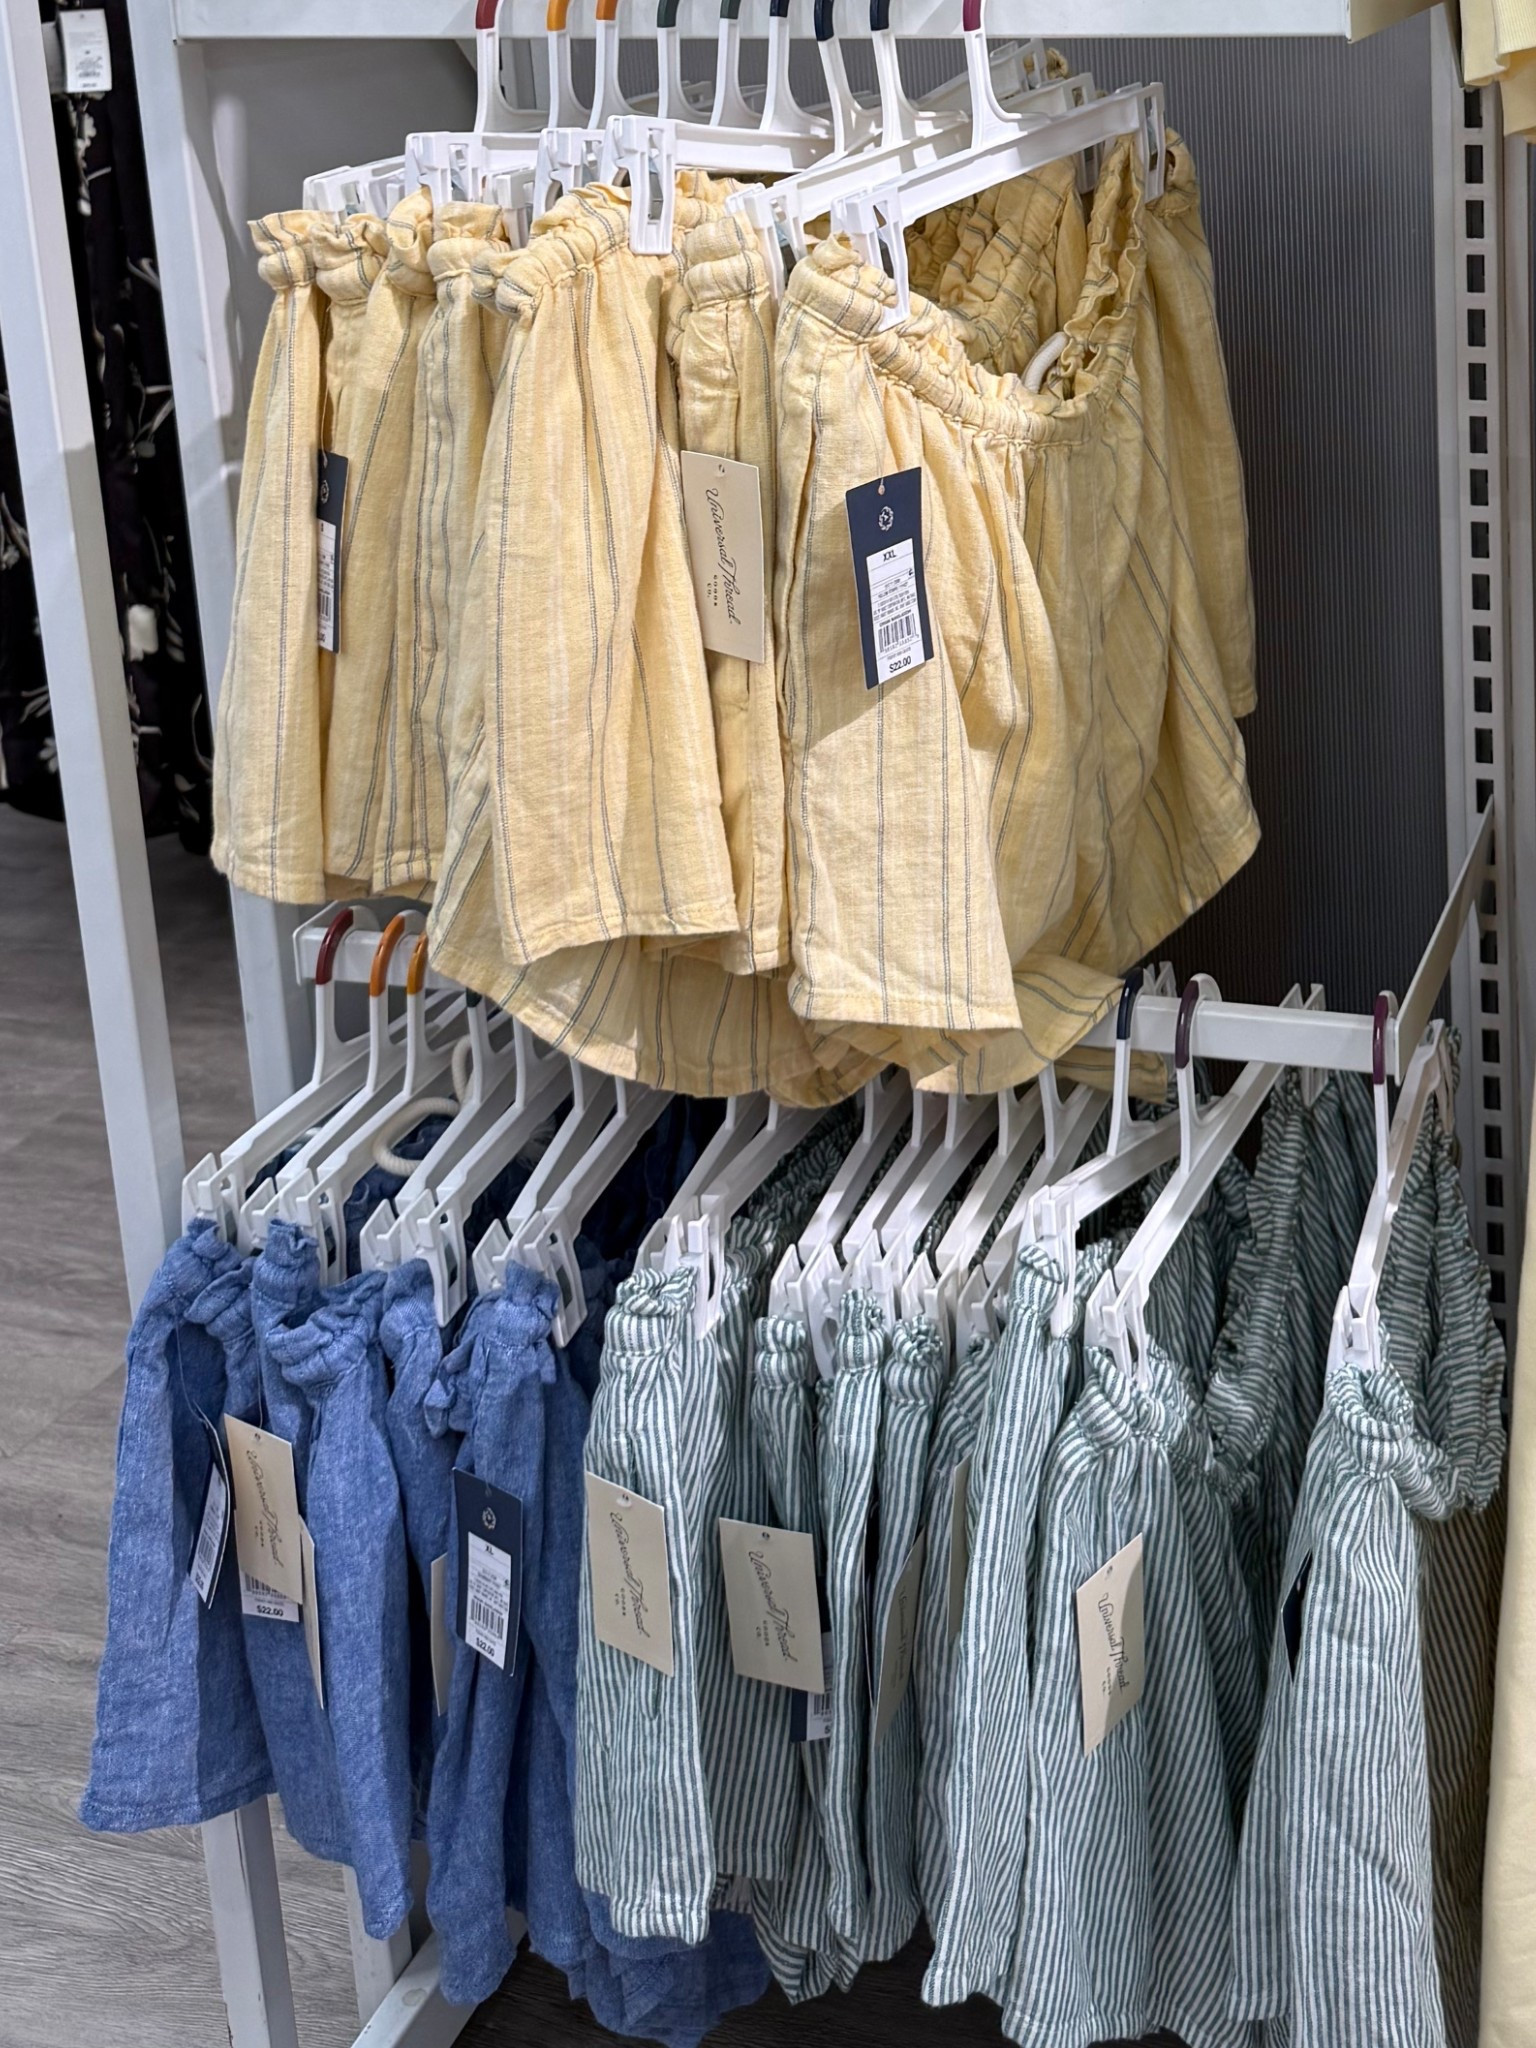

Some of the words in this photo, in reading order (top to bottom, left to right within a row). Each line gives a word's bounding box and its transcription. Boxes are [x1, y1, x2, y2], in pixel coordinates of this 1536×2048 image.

[705, 487, 731, 567] Universal
[883, 549, 897, 562] XXL
[889, 655, 912, 673] $22.00
[485, 1544, 495, 1556] XL
[256, 1605, 284, 1617] $22.00
[1097, 1592, 1122, 1651] Universal
[475, 1637, 496, 1657] $22.00
